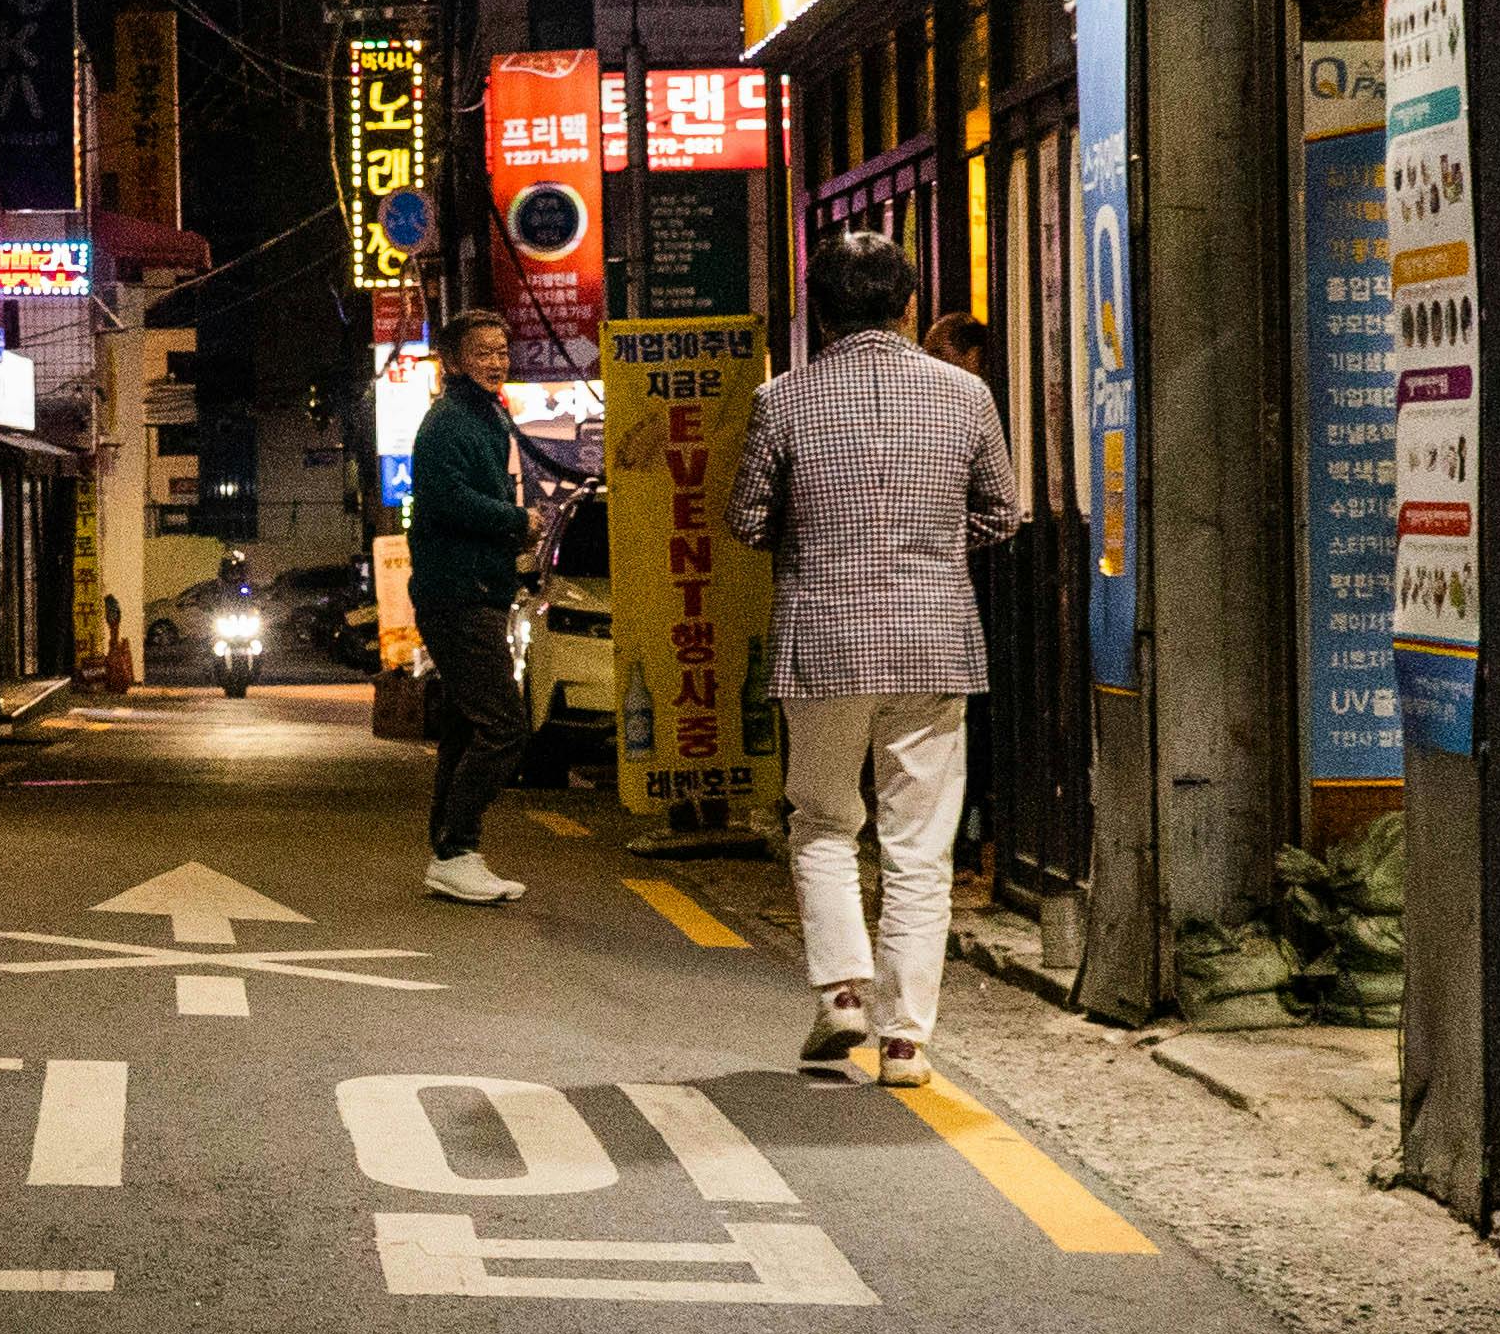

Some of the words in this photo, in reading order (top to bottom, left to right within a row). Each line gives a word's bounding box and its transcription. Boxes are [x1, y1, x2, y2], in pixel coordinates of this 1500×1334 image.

[501, 113, 588, 148] 프리맥
[613, 329, 754, 363] 개업30주년
[647, 370, 722, 400] 지금은
